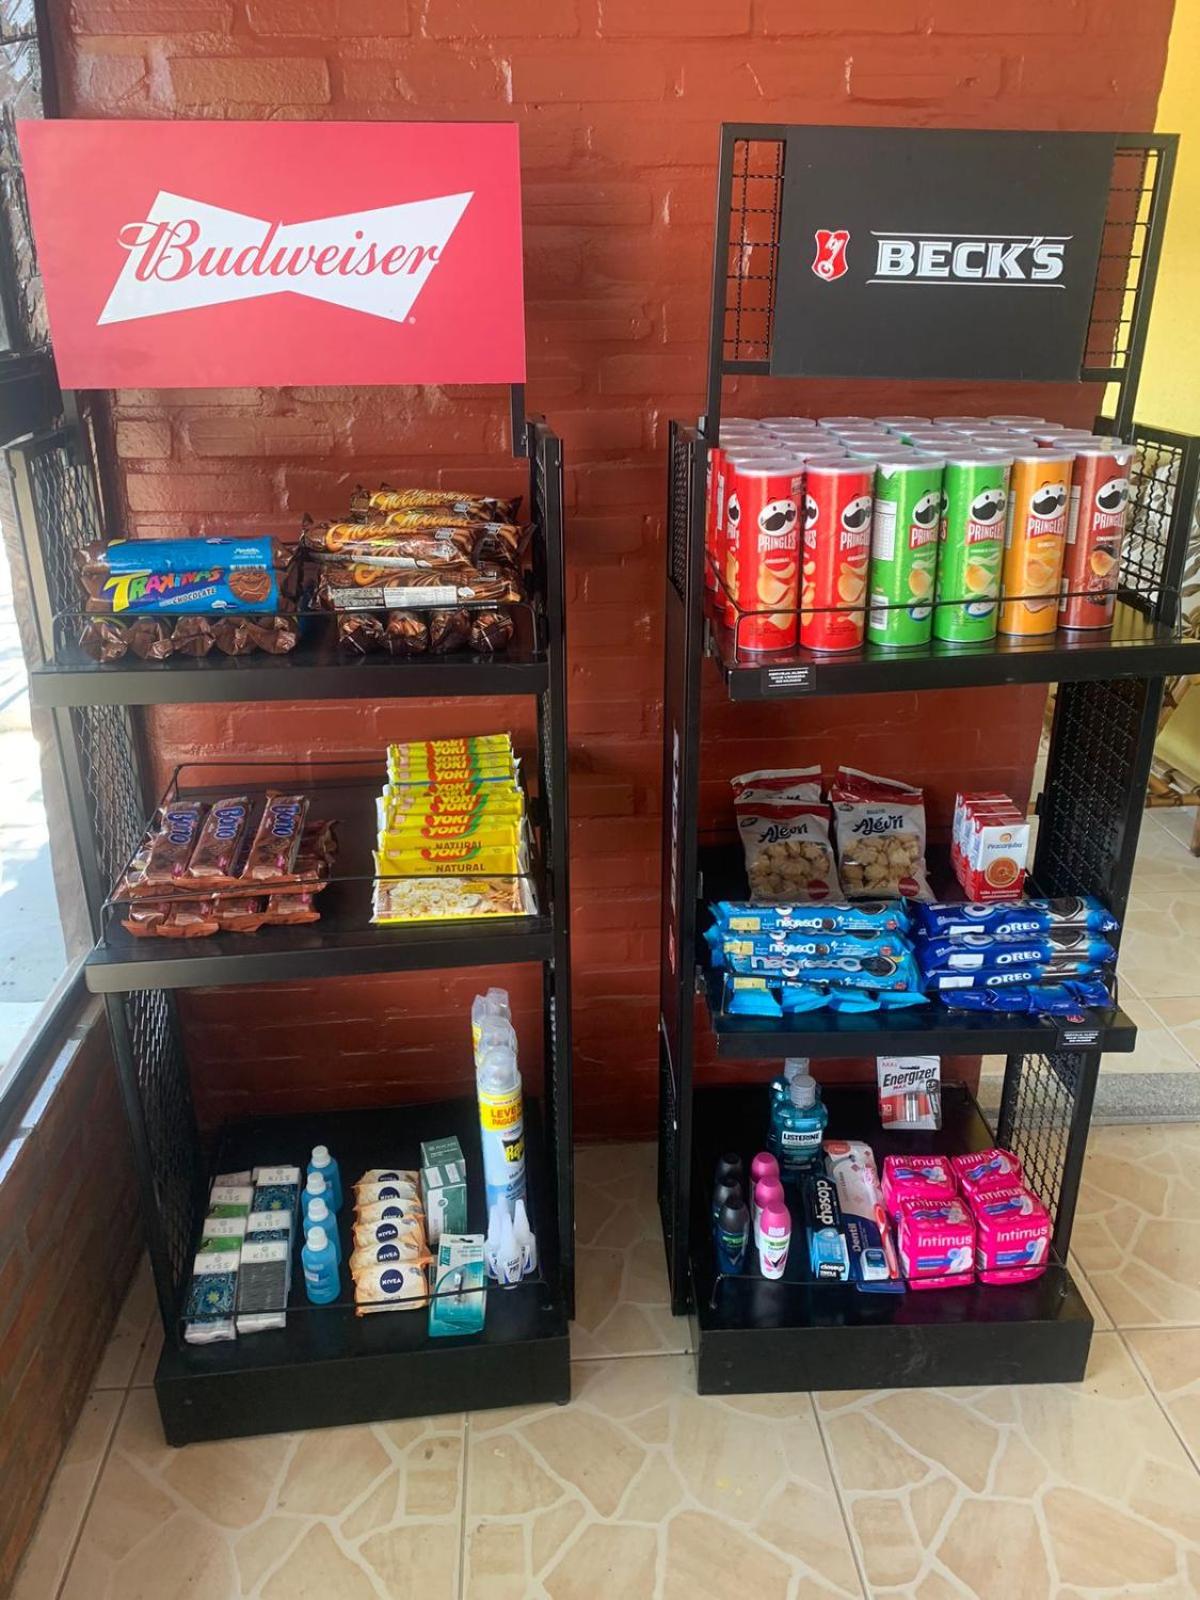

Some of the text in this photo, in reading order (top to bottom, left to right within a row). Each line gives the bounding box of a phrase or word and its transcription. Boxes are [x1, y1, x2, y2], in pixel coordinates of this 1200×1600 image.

[116, 219, 439, 282] Budweiser
[875, 236, 1065, 279] BECK'S
[758, 530, 796, 553] PRINGLES
[103, 567, 224, 612] TRAKINAS
[172, 587, 217, 605] CHOCOLATE
[436, 769, 470, 781] YOKI
[438, 801, 474, 812] YOKI
[432, 815, 470, 825] YOKI
[428, 825, 466, 836] YOKI
[430, 848, 467, 859] YOKI
[436, 863, 486, 873] NATURAL
[996, 922, 1041, 934] OREO
[996, 951, 1042, 965] OREO
[986, 972, 1032, 986] OREO
[883, 1067, 937, 1087] Energizer
[783, 1133, 820, 1141] LISTERINE
[975, 1187, 1026, 1203] Intimus
[817, 1180, 835, 1226] closeup
[378, 1229, 396, 1238] NIVEA
[996, 1226, 1049, 1242] Intimus
[918, 1234, 973, 1248] Intimus
[253, 1251, 278, 1259] KISS
[378, 1252, 398, 1260] NIVEA
[381, 1278, 402, 1286] NIVEA
